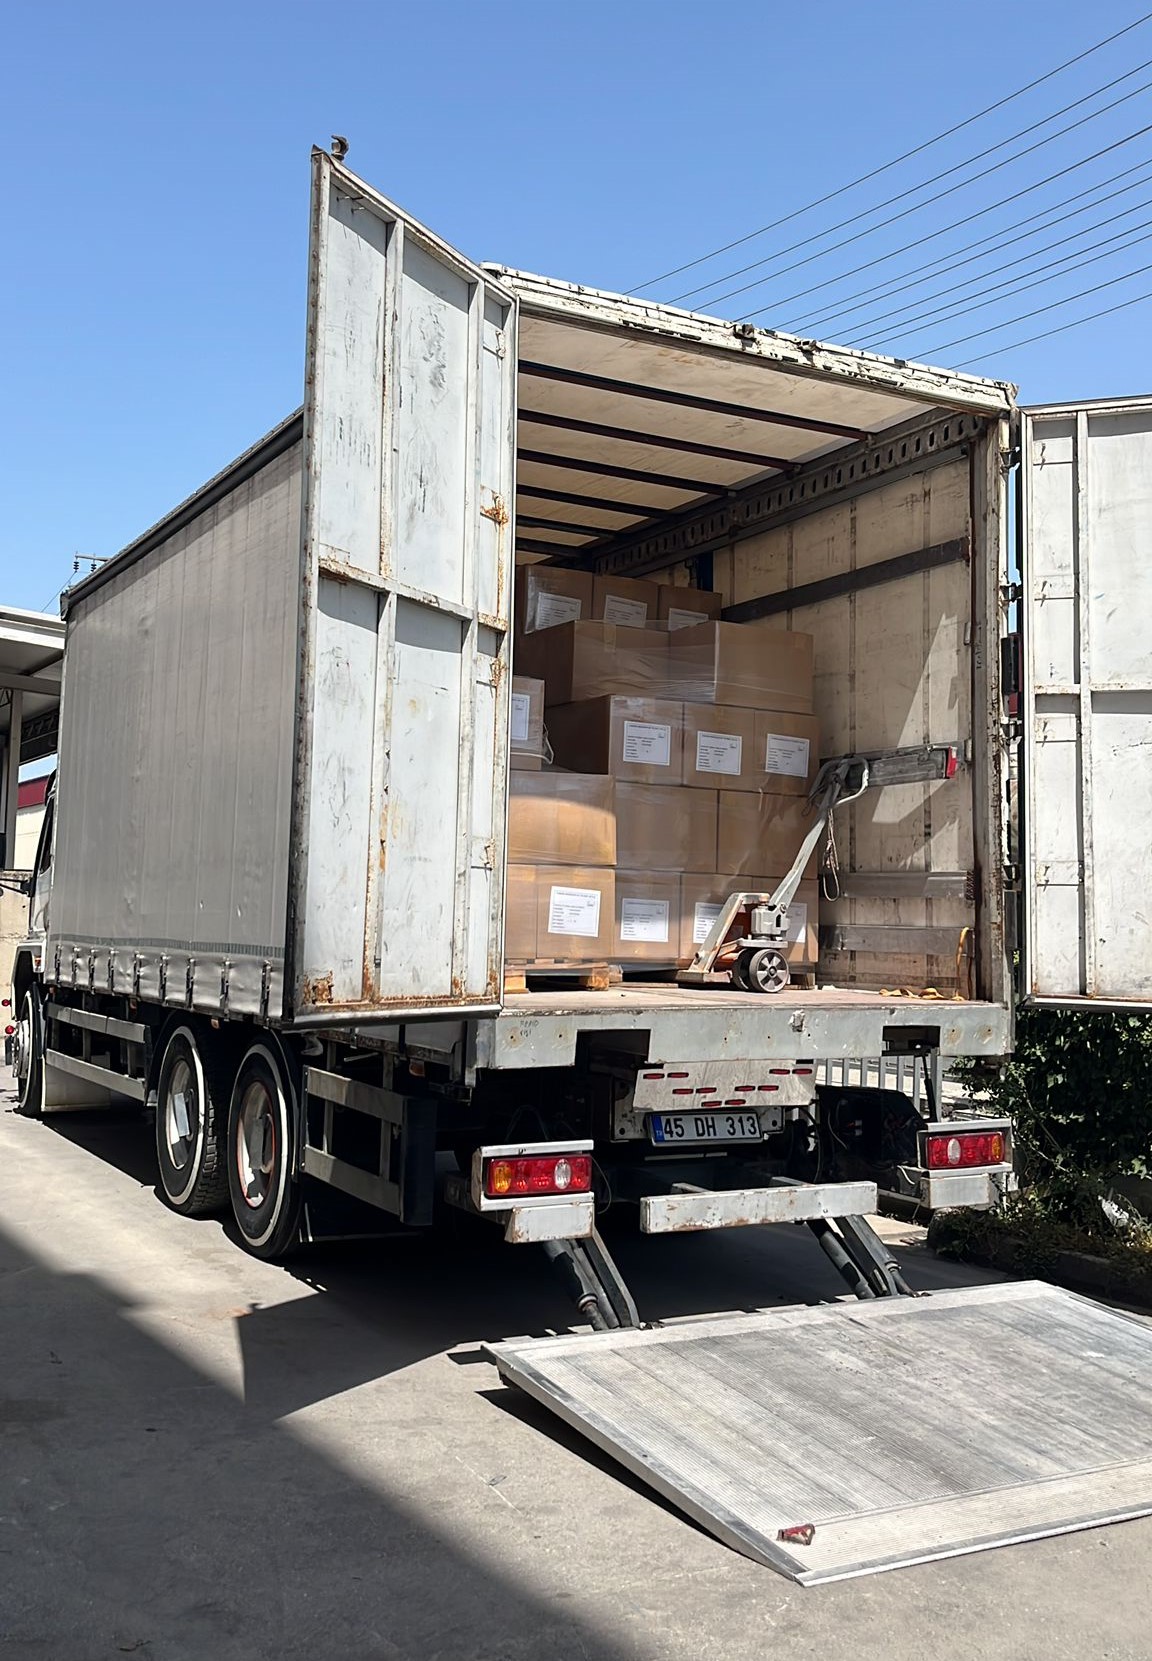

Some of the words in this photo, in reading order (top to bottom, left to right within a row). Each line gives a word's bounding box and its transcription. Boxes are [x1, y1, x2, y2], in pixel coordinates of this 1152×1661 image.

[664, 1117, 684, 1138] 45
[694, 1116, 717, 1137] DH
[726, 1115, 757, 1136] 313
